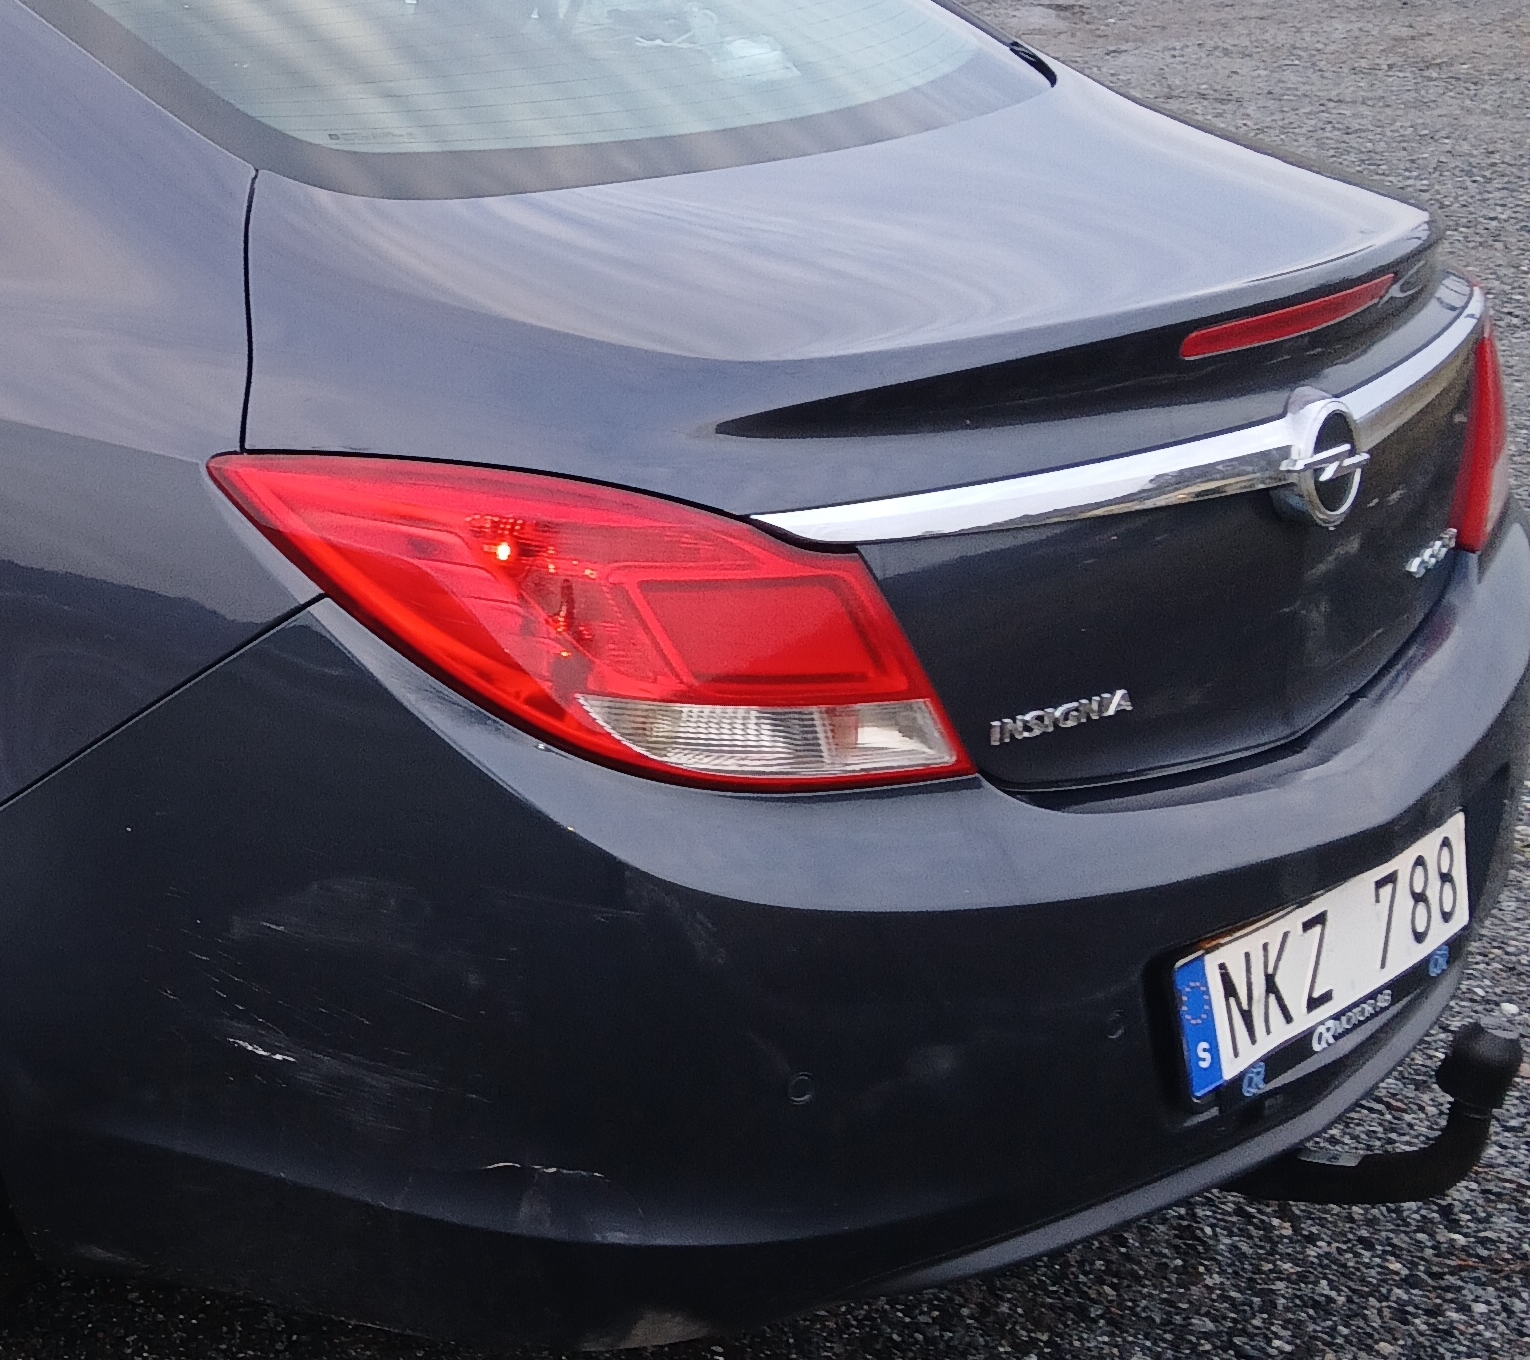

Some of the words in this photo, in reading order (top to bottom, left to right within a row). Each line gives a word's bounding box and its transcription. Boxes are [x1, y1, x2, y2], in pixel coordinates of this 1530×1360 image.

[990, 689, 1133, 746] INSIGNIA
[1217, 909, 1334, 1059] NKZ
[1374, 836, 1458, 970] 788
[1196, 1041, 1212, 1068] S
